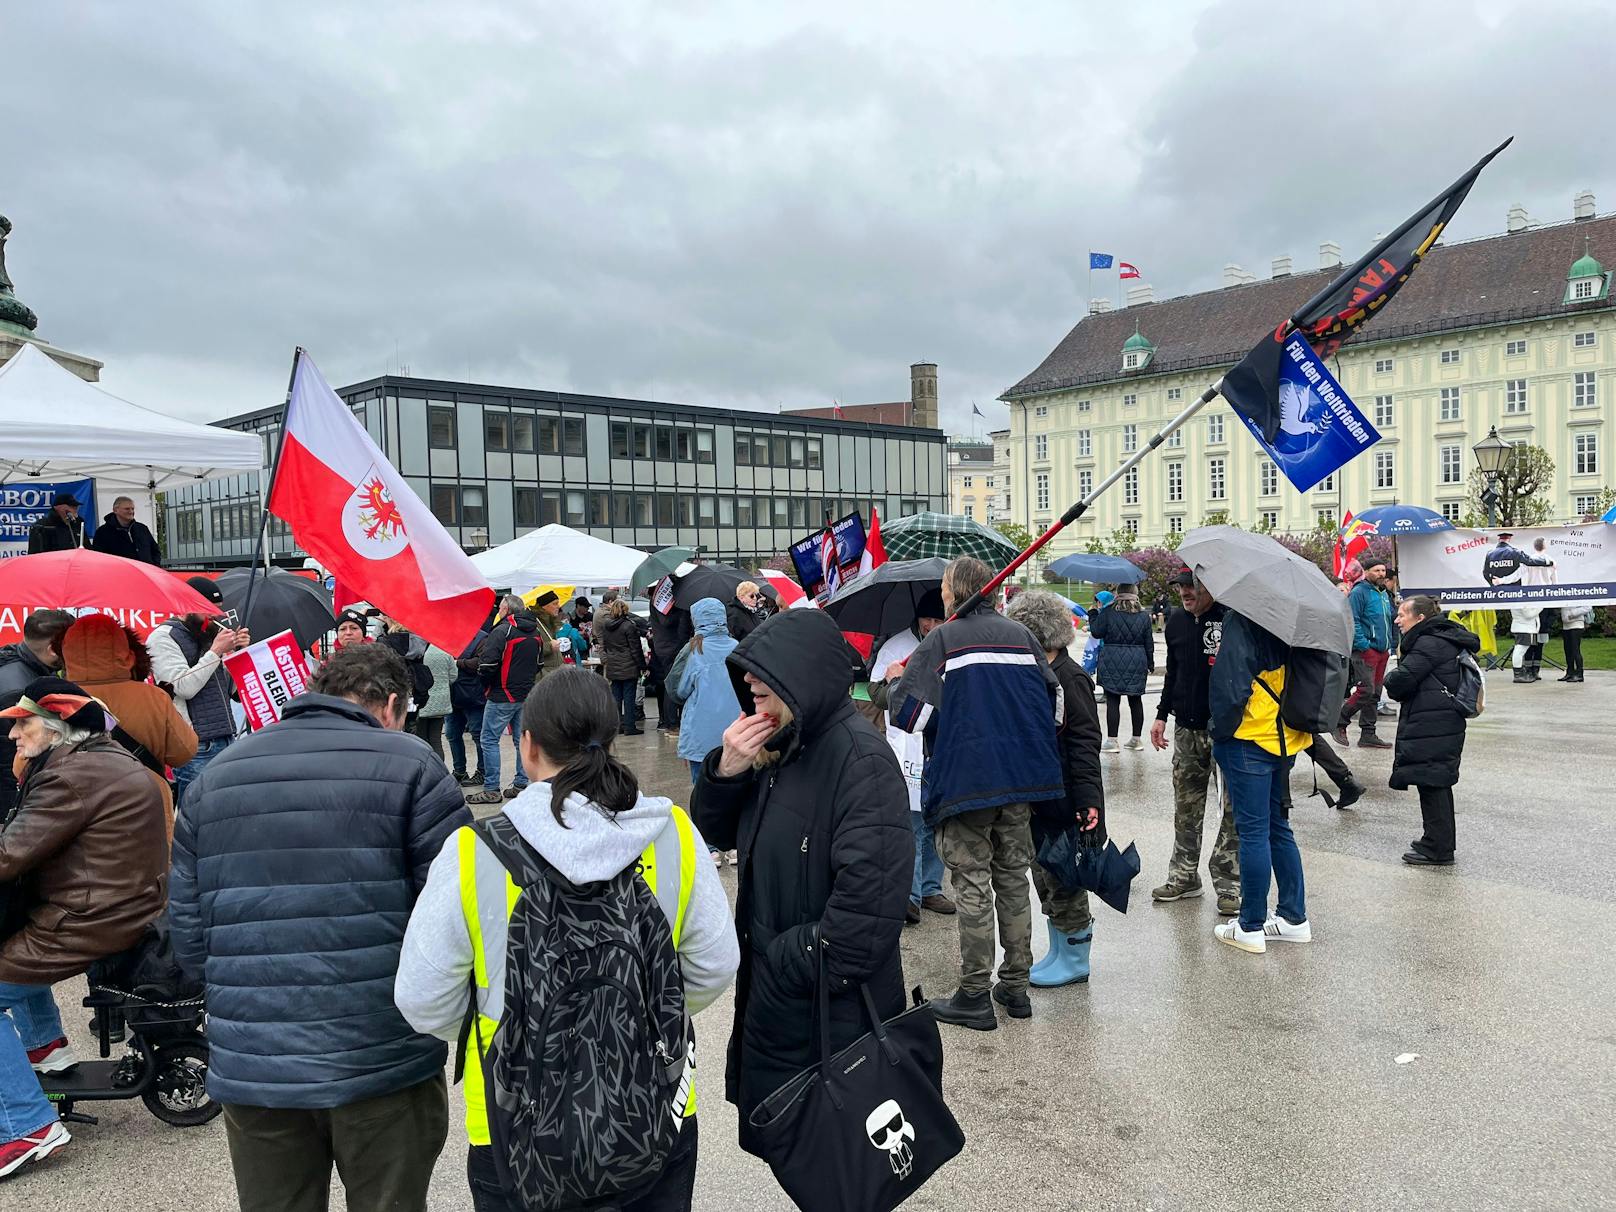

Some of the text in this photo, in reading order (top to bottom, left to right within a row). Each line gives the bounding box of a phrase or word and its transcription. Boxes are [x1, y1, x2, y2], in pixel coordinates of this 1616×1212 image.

[1286, 340, 1370, 444] Für den Weltfrieden
[0, 489, 56, 507] BOT
[796, 540, 812, 554] Wir
[1445, 536, 1489, 554] Es reicht!
[1550, 539, 1589, 547] gemeinsam
[1489, 559, 1514, 568] POLIZEI
[1441, 586, 1608, 600] Polizisten für Grund- und Freiheitsrechte
